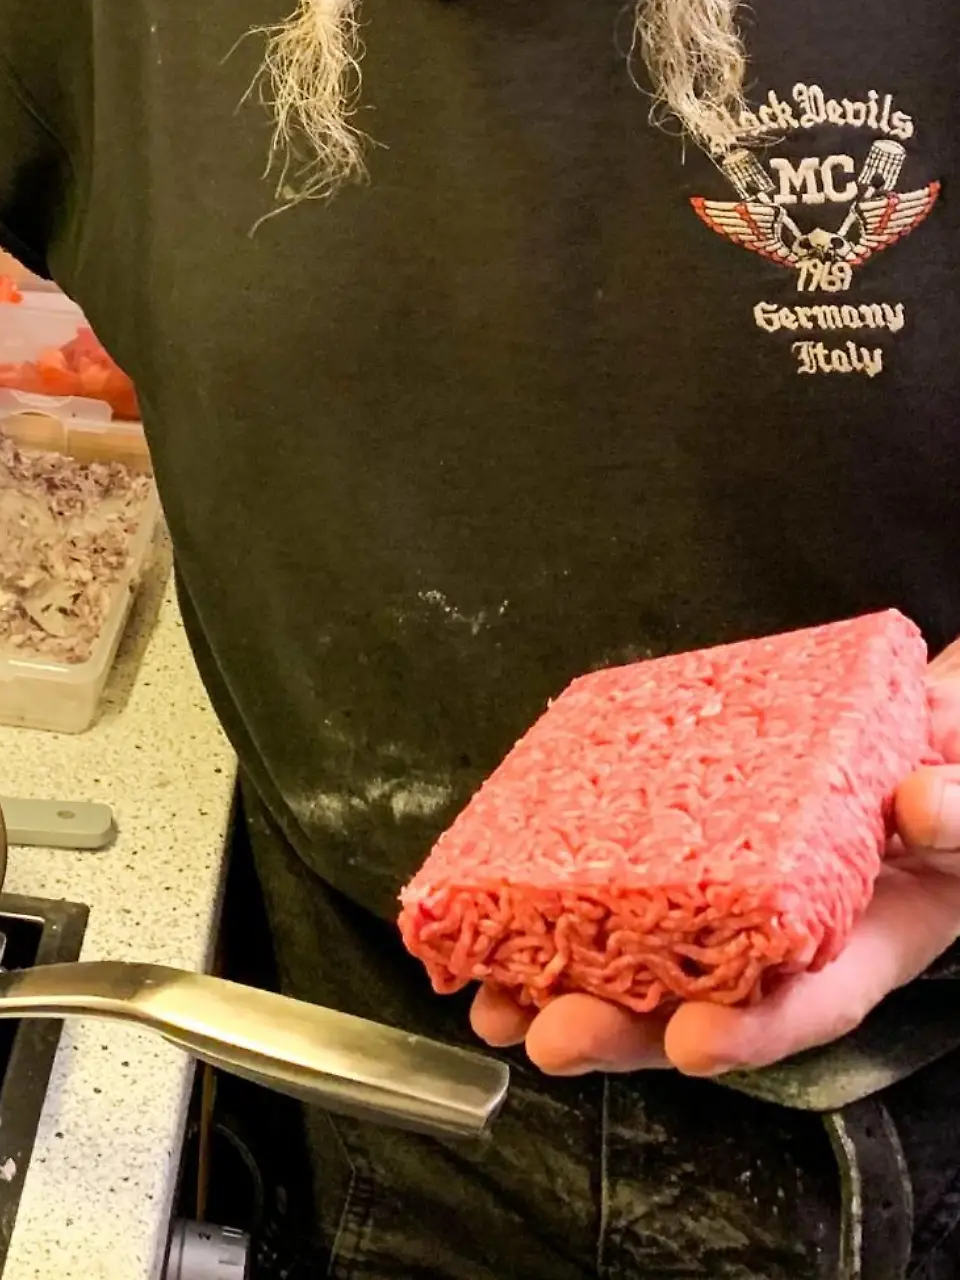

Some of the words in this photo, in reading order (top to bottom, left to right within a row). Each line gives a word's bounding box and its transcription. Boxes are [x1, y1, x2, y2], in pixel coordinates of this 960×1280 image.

[738, 89, 800, 132] ack
[792, 82, 915, 140] Devils
[769, 154, 859, 204] MC
[795, 258, 853, 292] 1969
[752, 300, 906, 334] Germany
[791, 340, 883, 378] Italy
